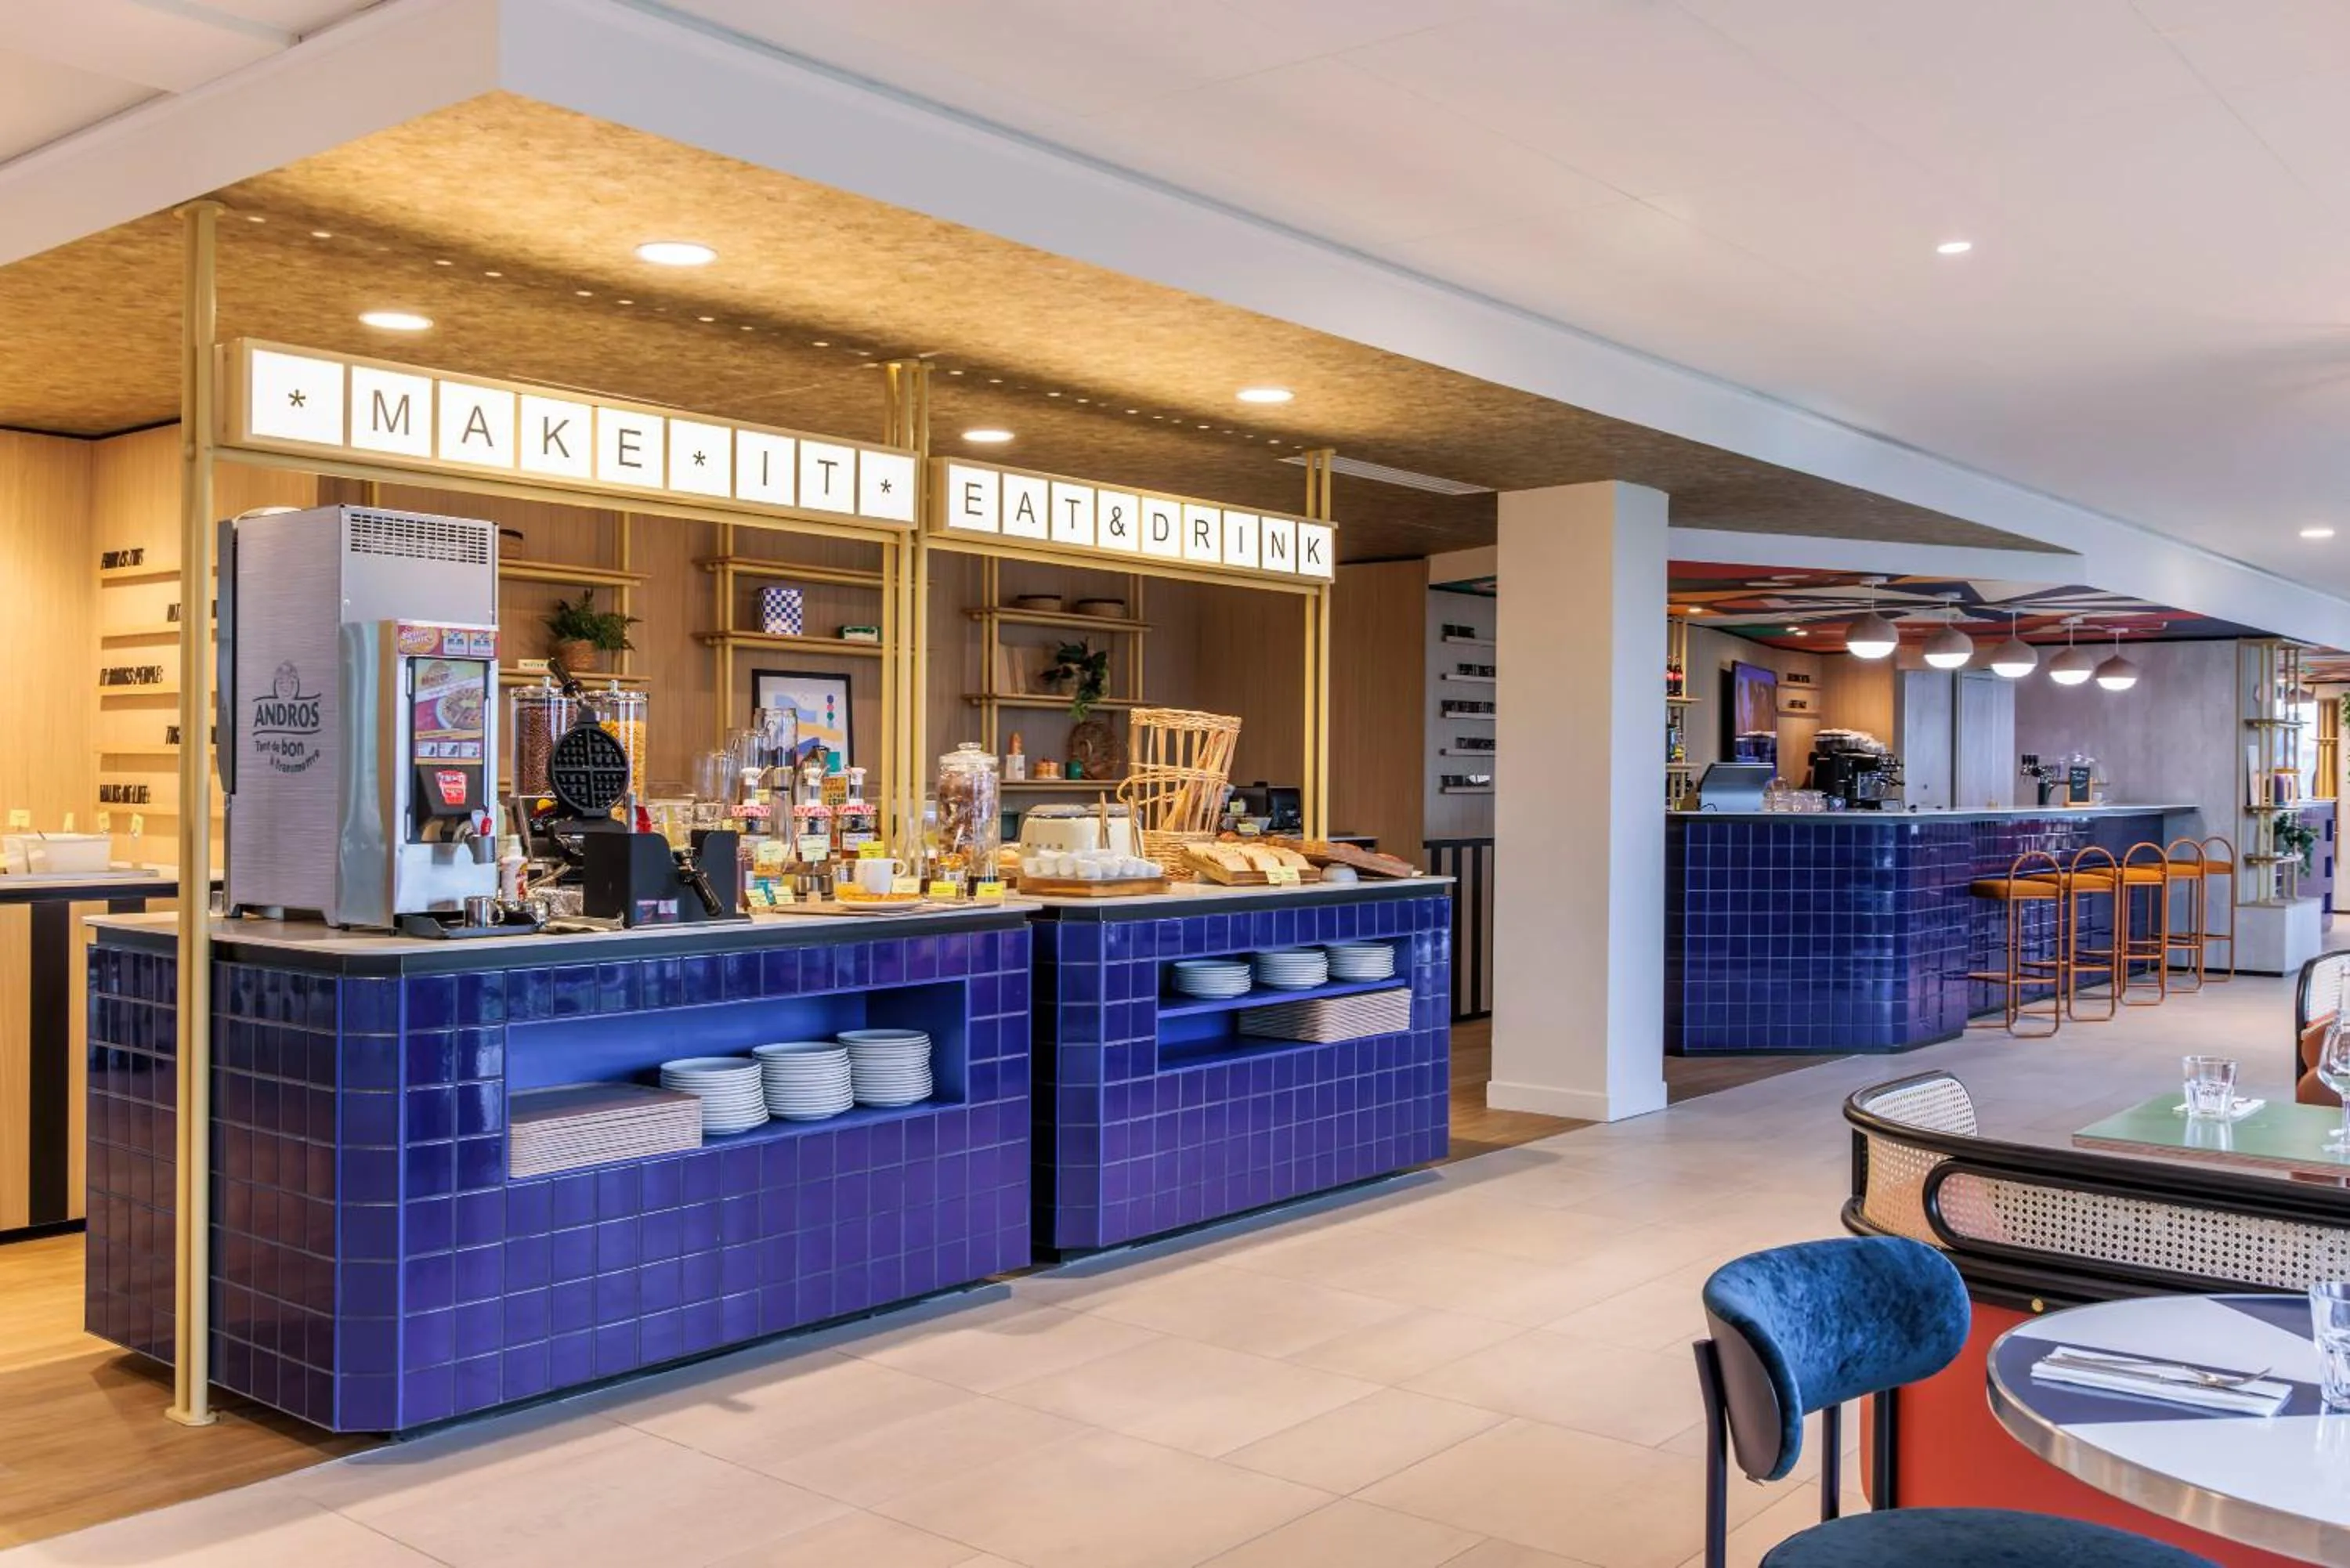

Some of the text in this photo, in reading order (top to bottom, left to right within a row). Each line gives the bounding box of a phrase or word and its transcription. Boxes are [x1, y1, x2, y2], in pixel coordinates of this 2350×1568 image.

[374, 389, 839, 495] MAKE IT
[254, 702, 320, 728] ANDROS
[281, 739, 305, 757] bon
